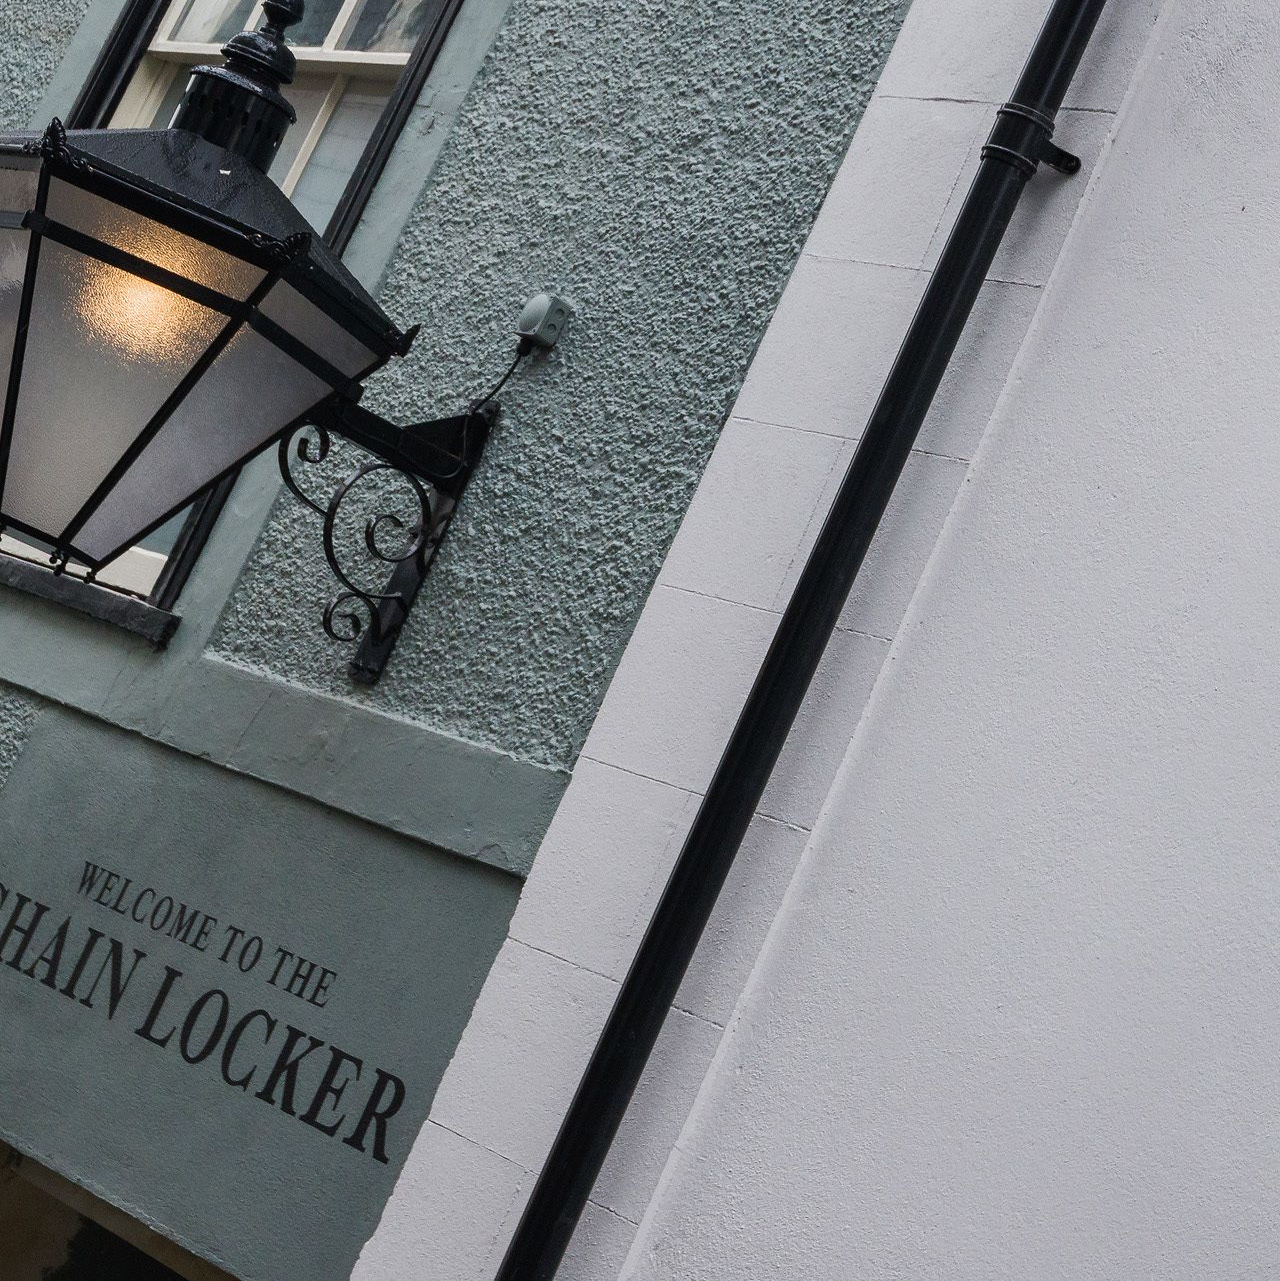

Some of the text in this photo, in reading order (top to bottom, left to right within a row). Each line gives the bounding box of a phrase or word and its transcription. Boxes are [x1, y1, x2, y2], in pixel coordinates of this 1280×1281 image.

[77, 861, 338, 1009] WELCOME TO THE
[134, 965, 407, 1164] LOCKER
